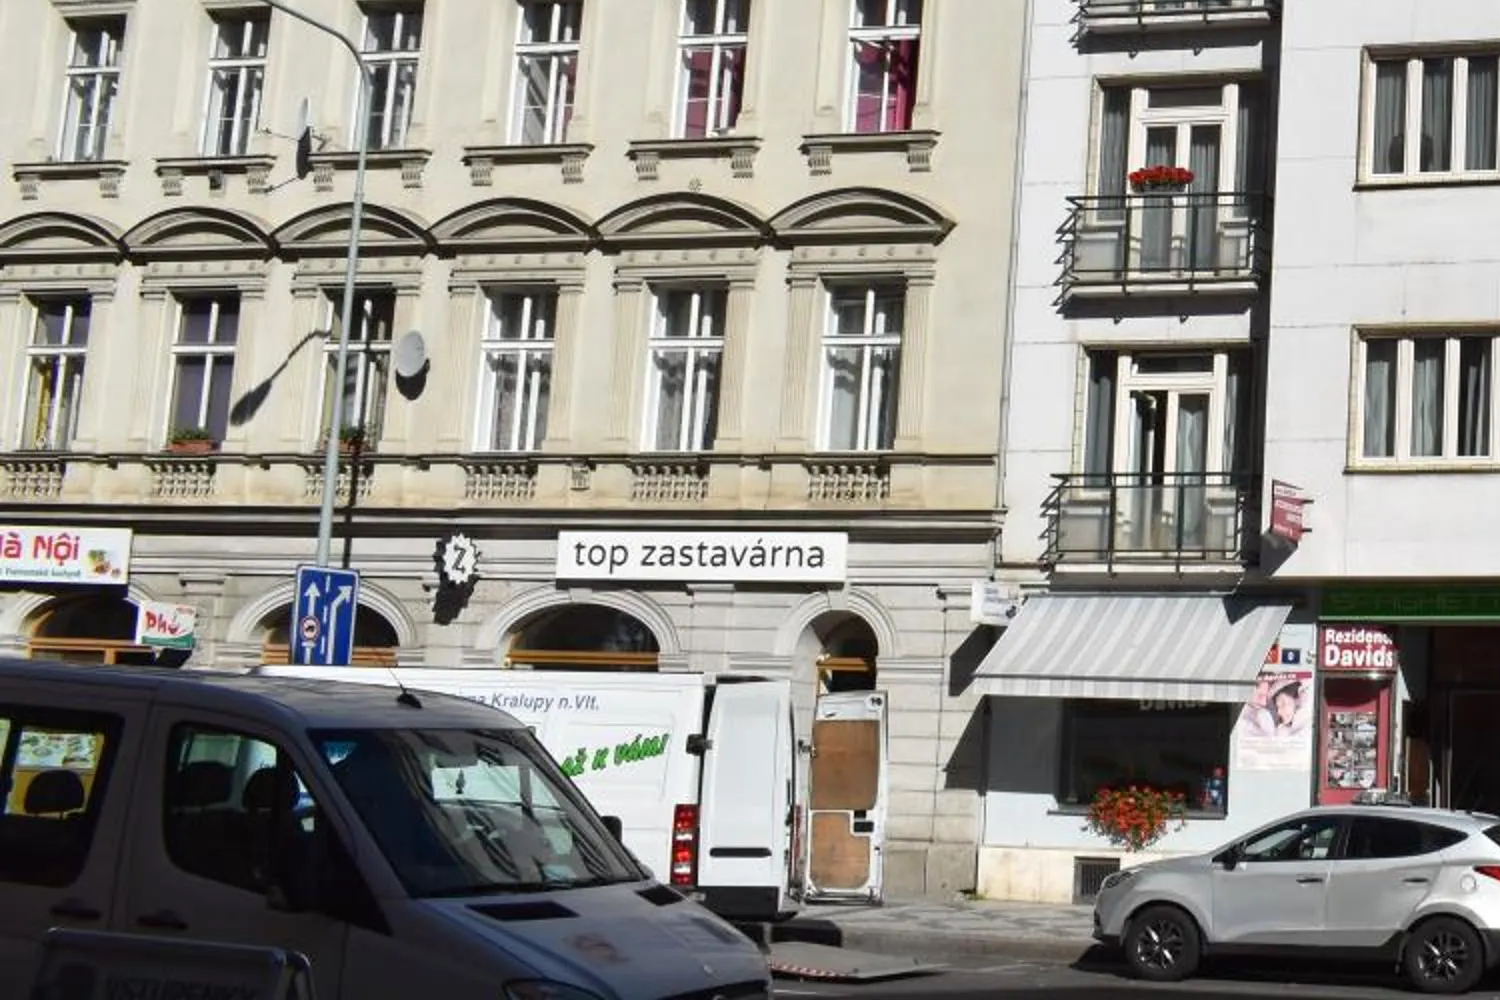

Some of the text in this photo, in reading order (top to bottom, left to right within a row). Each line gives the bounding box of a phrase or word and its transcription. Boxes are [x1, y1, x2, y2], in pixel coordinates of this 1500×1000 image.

[34, 531, 81, 566] Nội
[575, 538, 825, 573] top zastavárna
[1325, 644, 1394, 668] Davids
[491, 692, 554, 713] Kralupy
